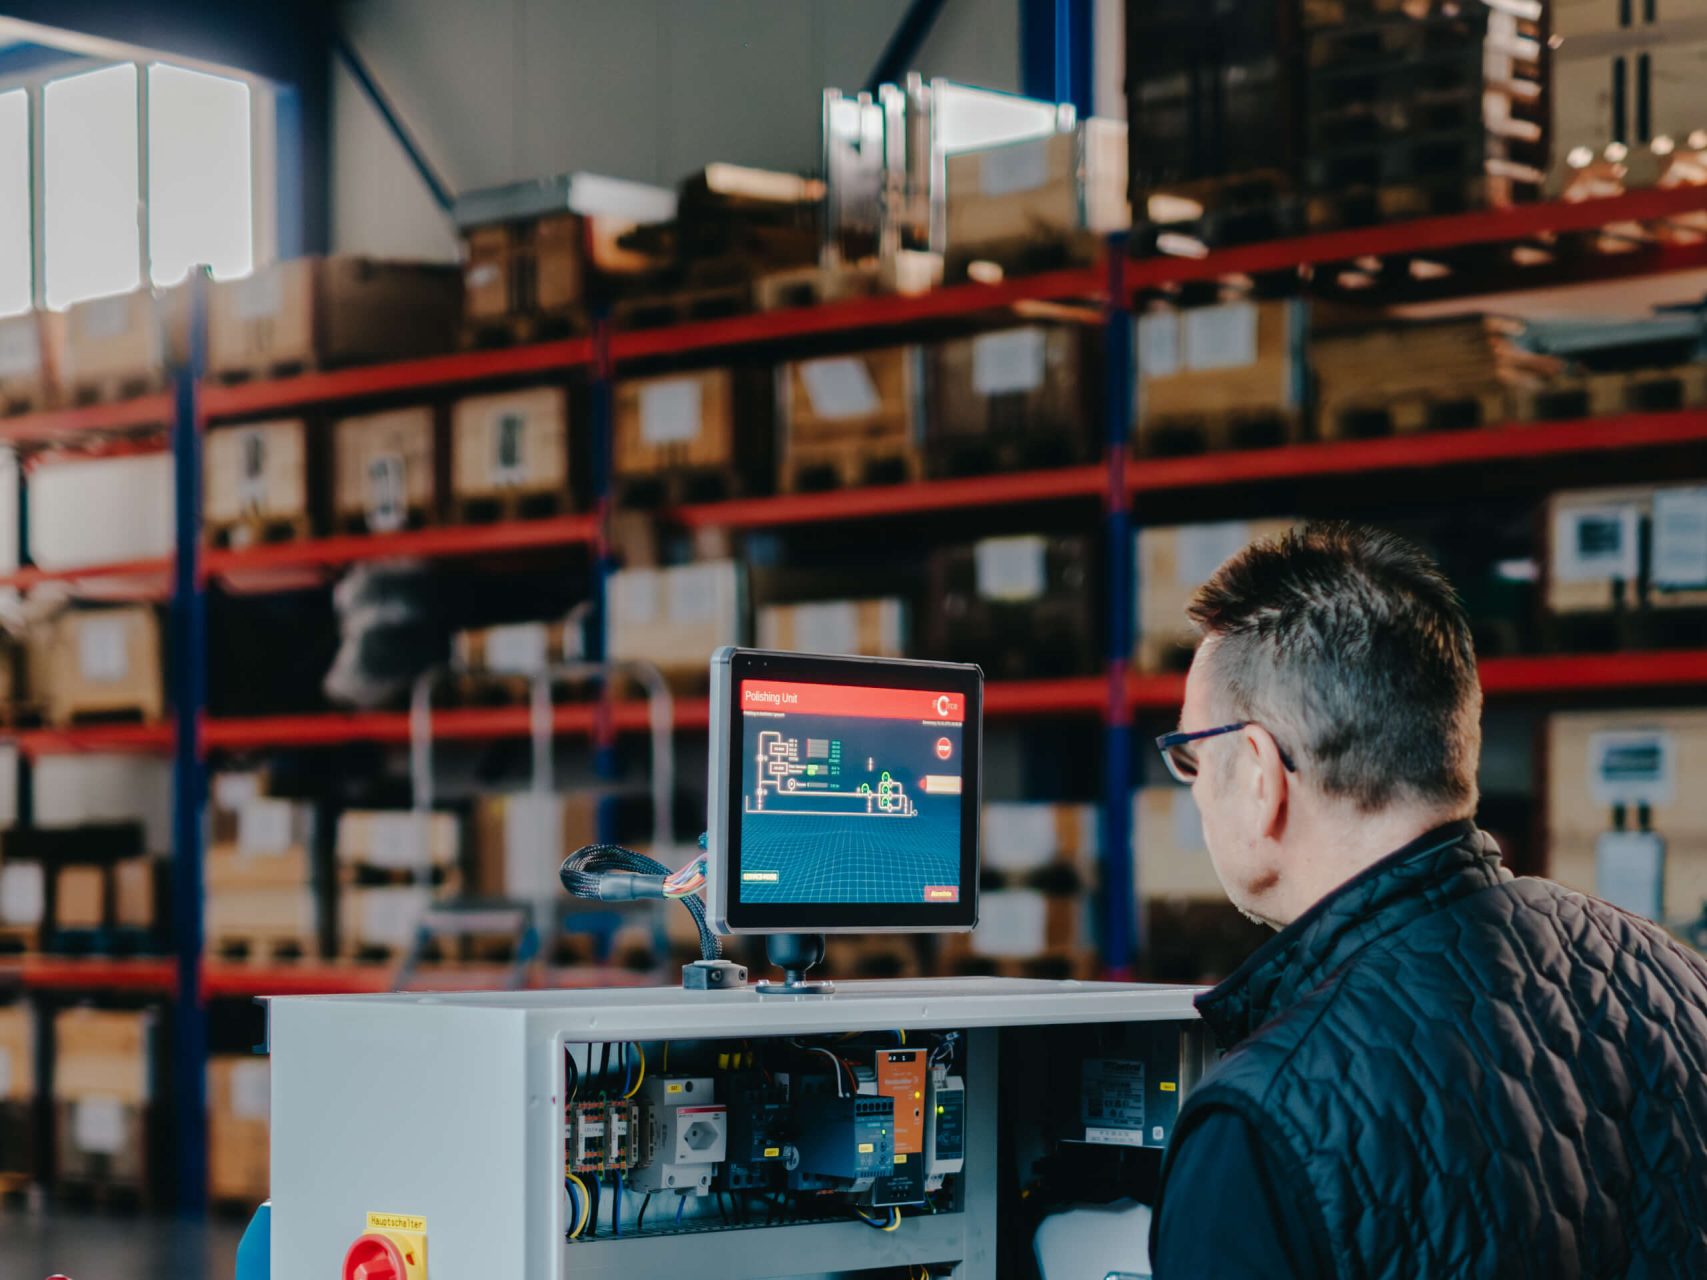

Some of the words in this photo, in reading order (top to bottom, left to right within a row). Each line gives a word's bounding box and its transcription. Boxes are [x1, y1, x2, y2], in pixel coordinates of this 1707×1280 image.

[745, 690, 780, 705] Polishing
[782, 692, 798, 704] Unit
[371, 1215, 423, 1229] Hauptschalter
